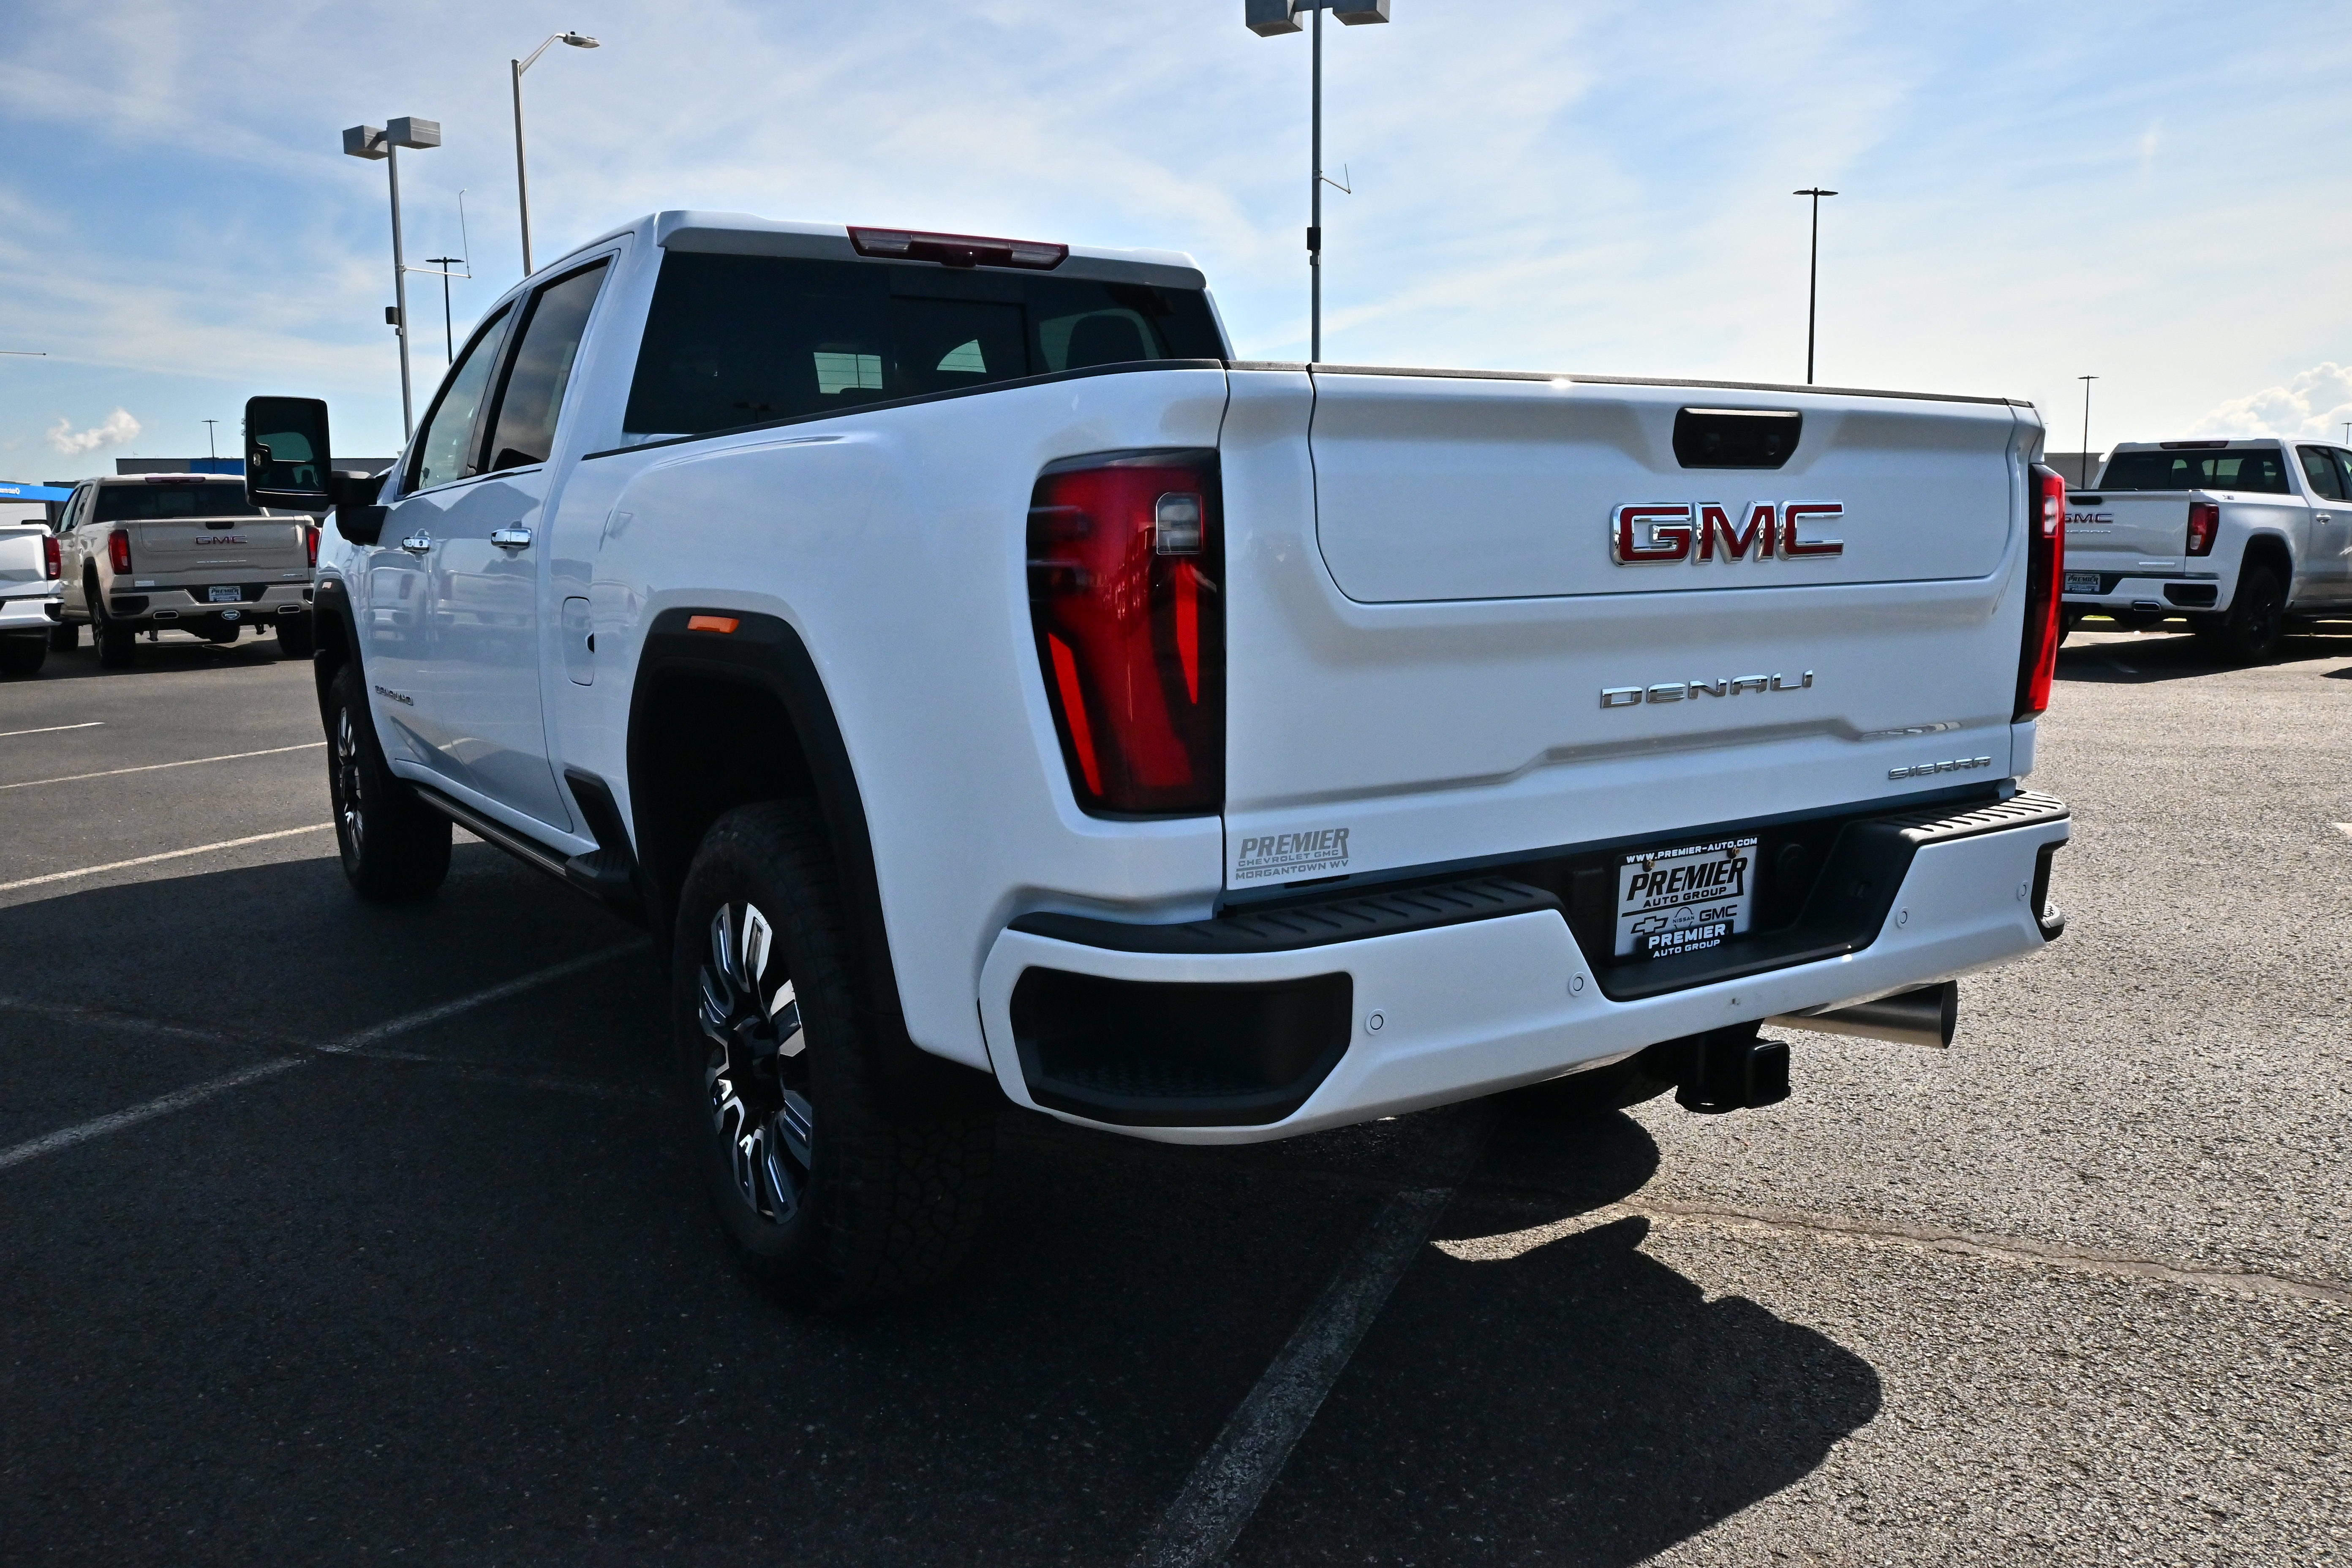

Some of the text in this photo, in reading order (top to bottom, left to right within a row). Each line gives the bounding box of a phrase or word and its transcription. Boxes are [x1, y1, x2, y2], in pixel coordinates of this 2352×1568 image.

[195, 535, 247, 544] GMC
[1610, 500, 1844, 566] GMC
[2068, 576, 2098, 585] PREMIER
[1600, 670, 1813, 709] DENALI
[1888, 756, 1991, 779] SIERRA
[1239, 828, 1350, 859] PREMIER
[1627, 837, 1758, 863] WWW.PREMIER-AUTO.COM
[1239, 849, 1339, 866] CHEVROLET GMC
[1236, 860, 1349, 880] MORGANTOWN WV
[1626, 857, 1748, 901] PREMIER
[1643, 887, 1727, 908] AUTO GROUP
[1673, 915, 1695, 924] NISSAN
[1699, 905, 1737, 922] GMC
[1648, 924, 1725, 949] PREMIER
[1653, 939, 1720, 958] AUTO GROUP
